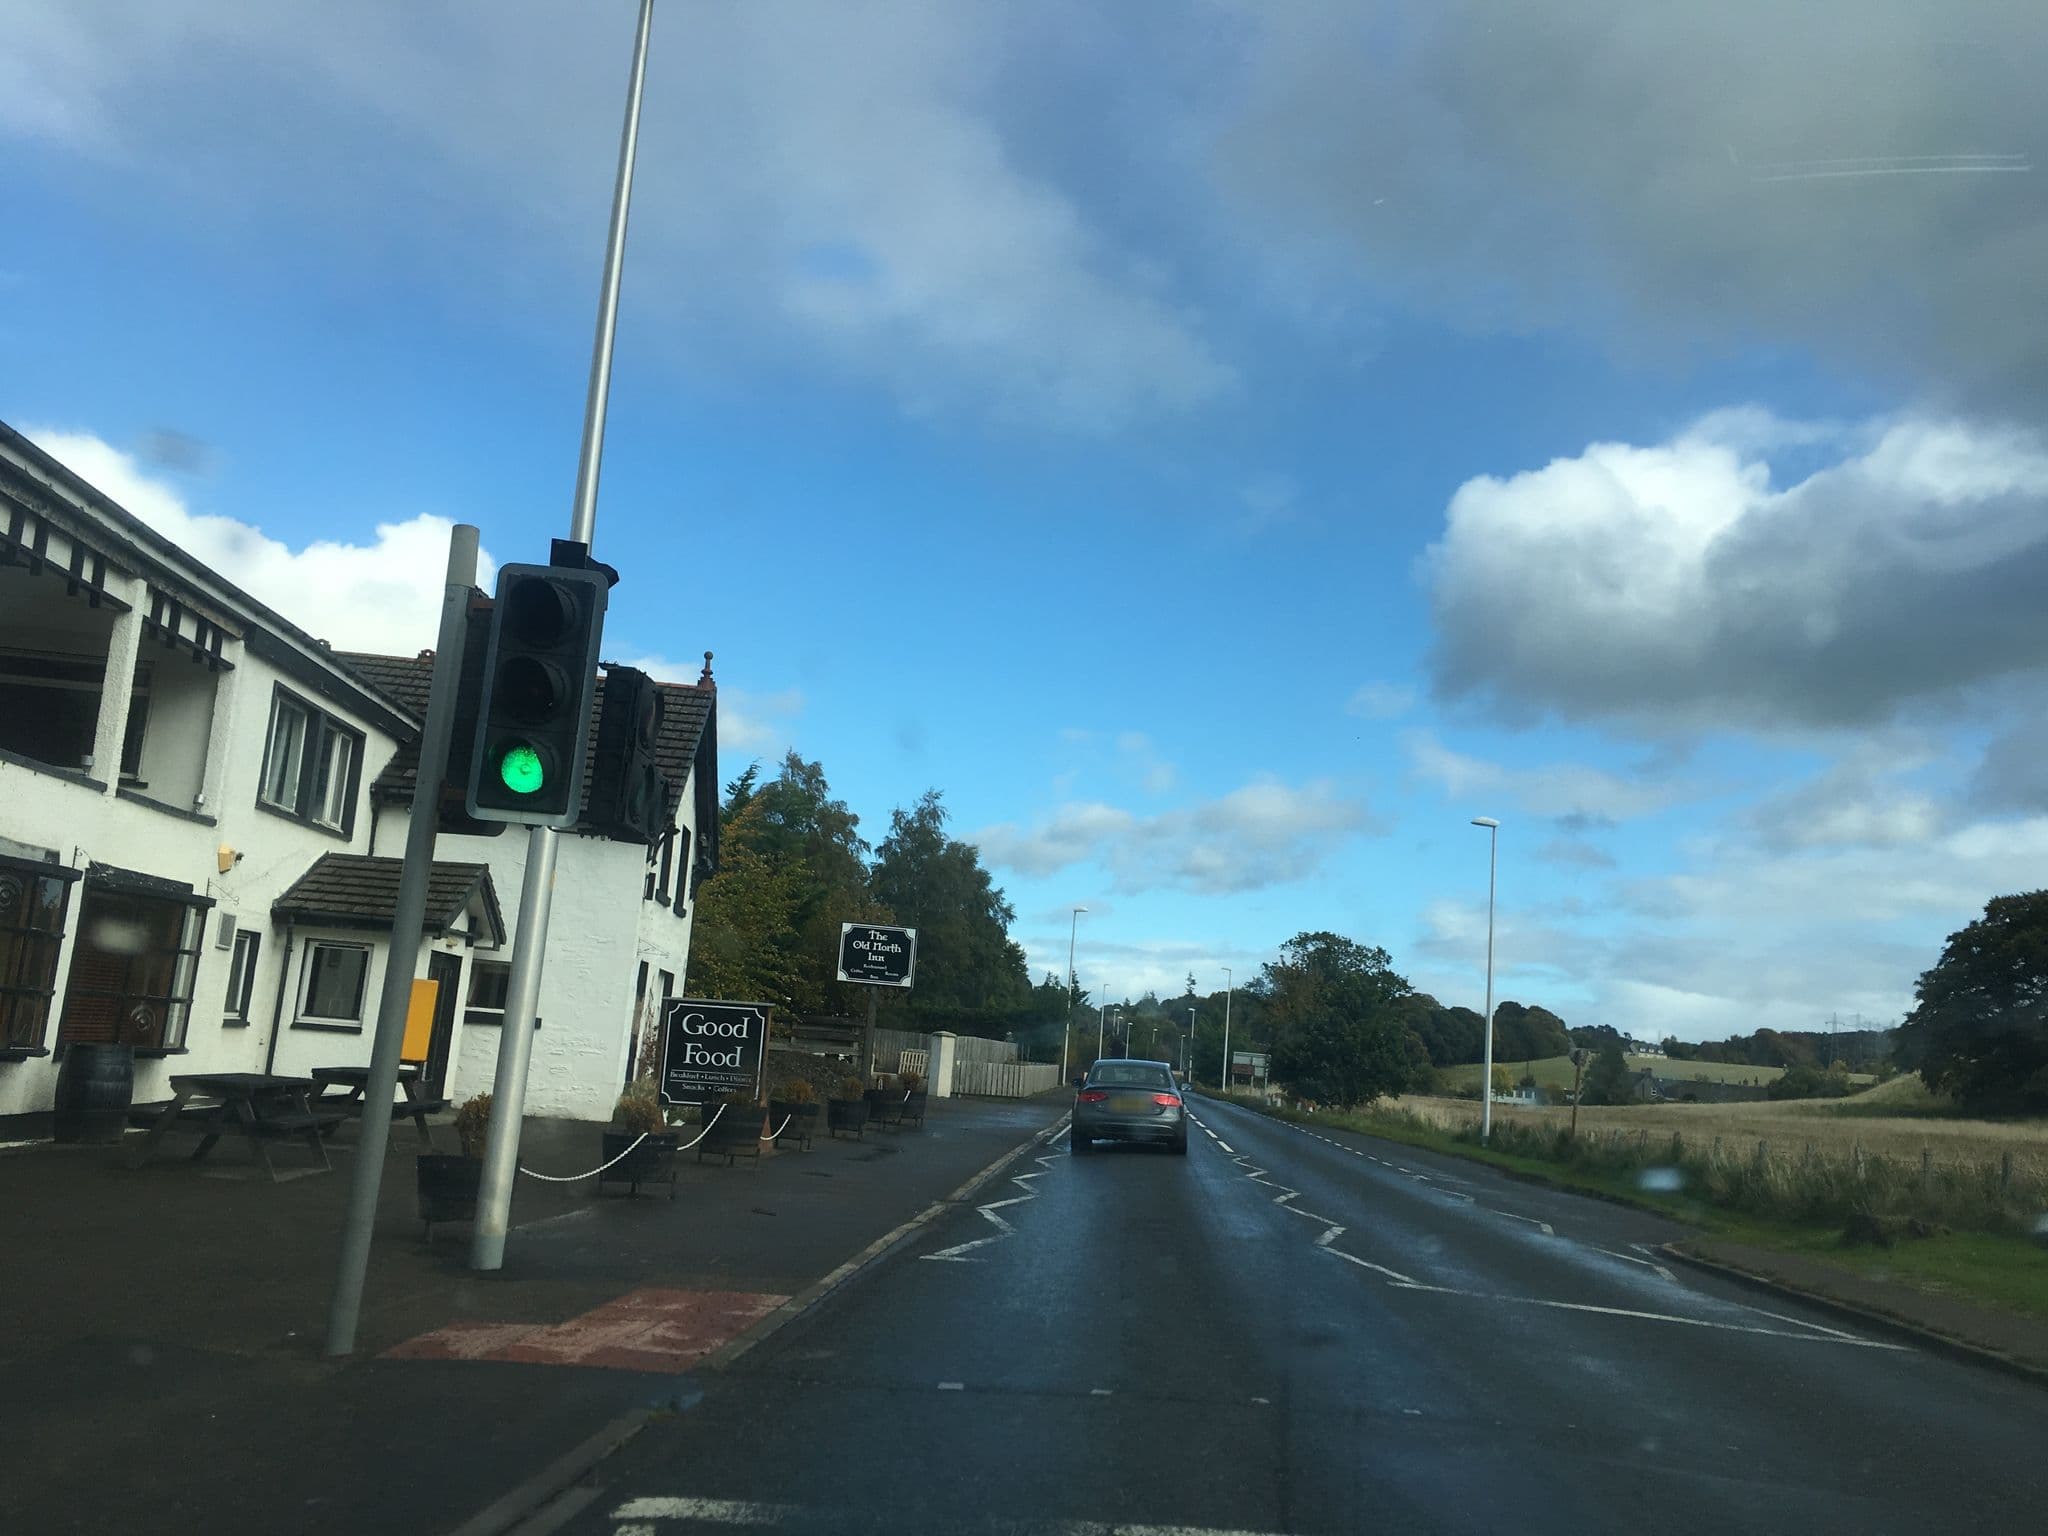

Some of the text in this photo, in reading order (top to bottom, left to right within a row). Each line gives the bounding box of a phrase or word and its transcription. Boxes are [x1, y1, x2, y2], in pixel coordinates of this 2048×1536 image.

[868, 930, 888, 941] The
[852, 940, 902, 953] Old North
[867, 952, 885, 962] Inn
[682, 1013, 750, 1039] Good
[683, 1043, 743, 1067] Food
